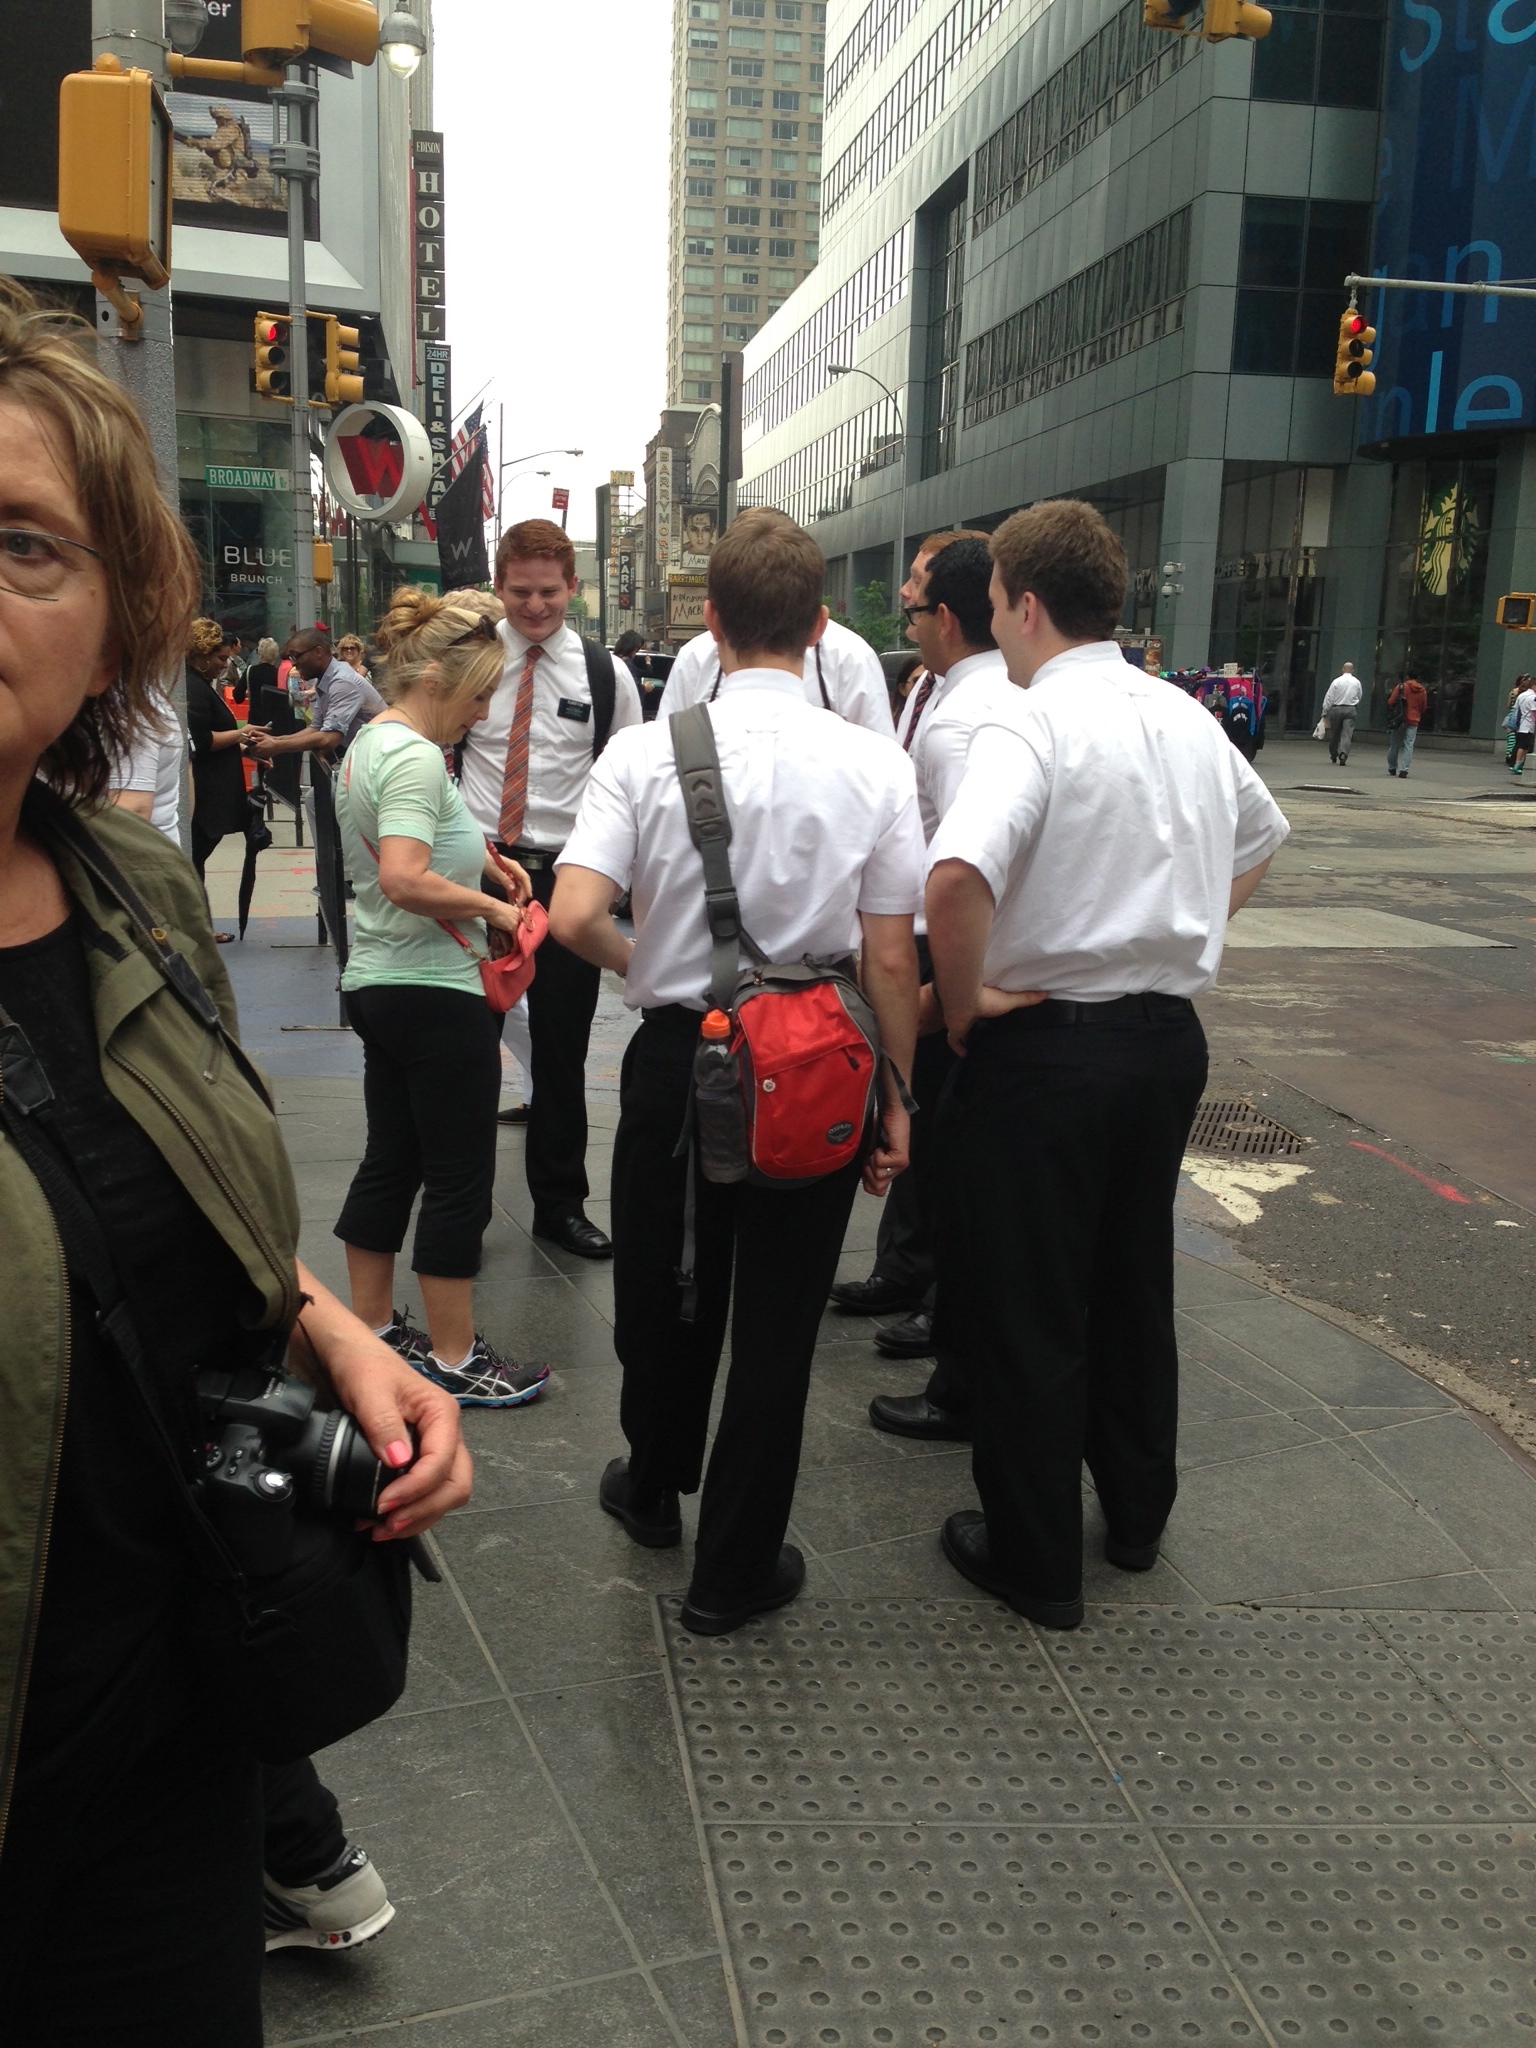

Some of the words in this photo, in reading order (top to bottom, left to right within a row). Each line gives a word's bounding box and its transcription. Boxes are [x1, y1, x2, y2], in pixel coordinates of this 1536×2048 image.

[201, 0, 232, 18] er
[416, 141, 441, 154] EDISON
[418, 171, 441, 333] HOTEL
[209, 469, 276, 487] BROADWAY
[658, 451, 670, 561] BARRYMORE
[224, 545, 293, 568] BLUE
[450, 537, 473, 561] W
[230, 573, 283, 584] BRUNCH
[620, 555, 630, 593] PARK
[669, 574, 706, 584] BARRYMORE
